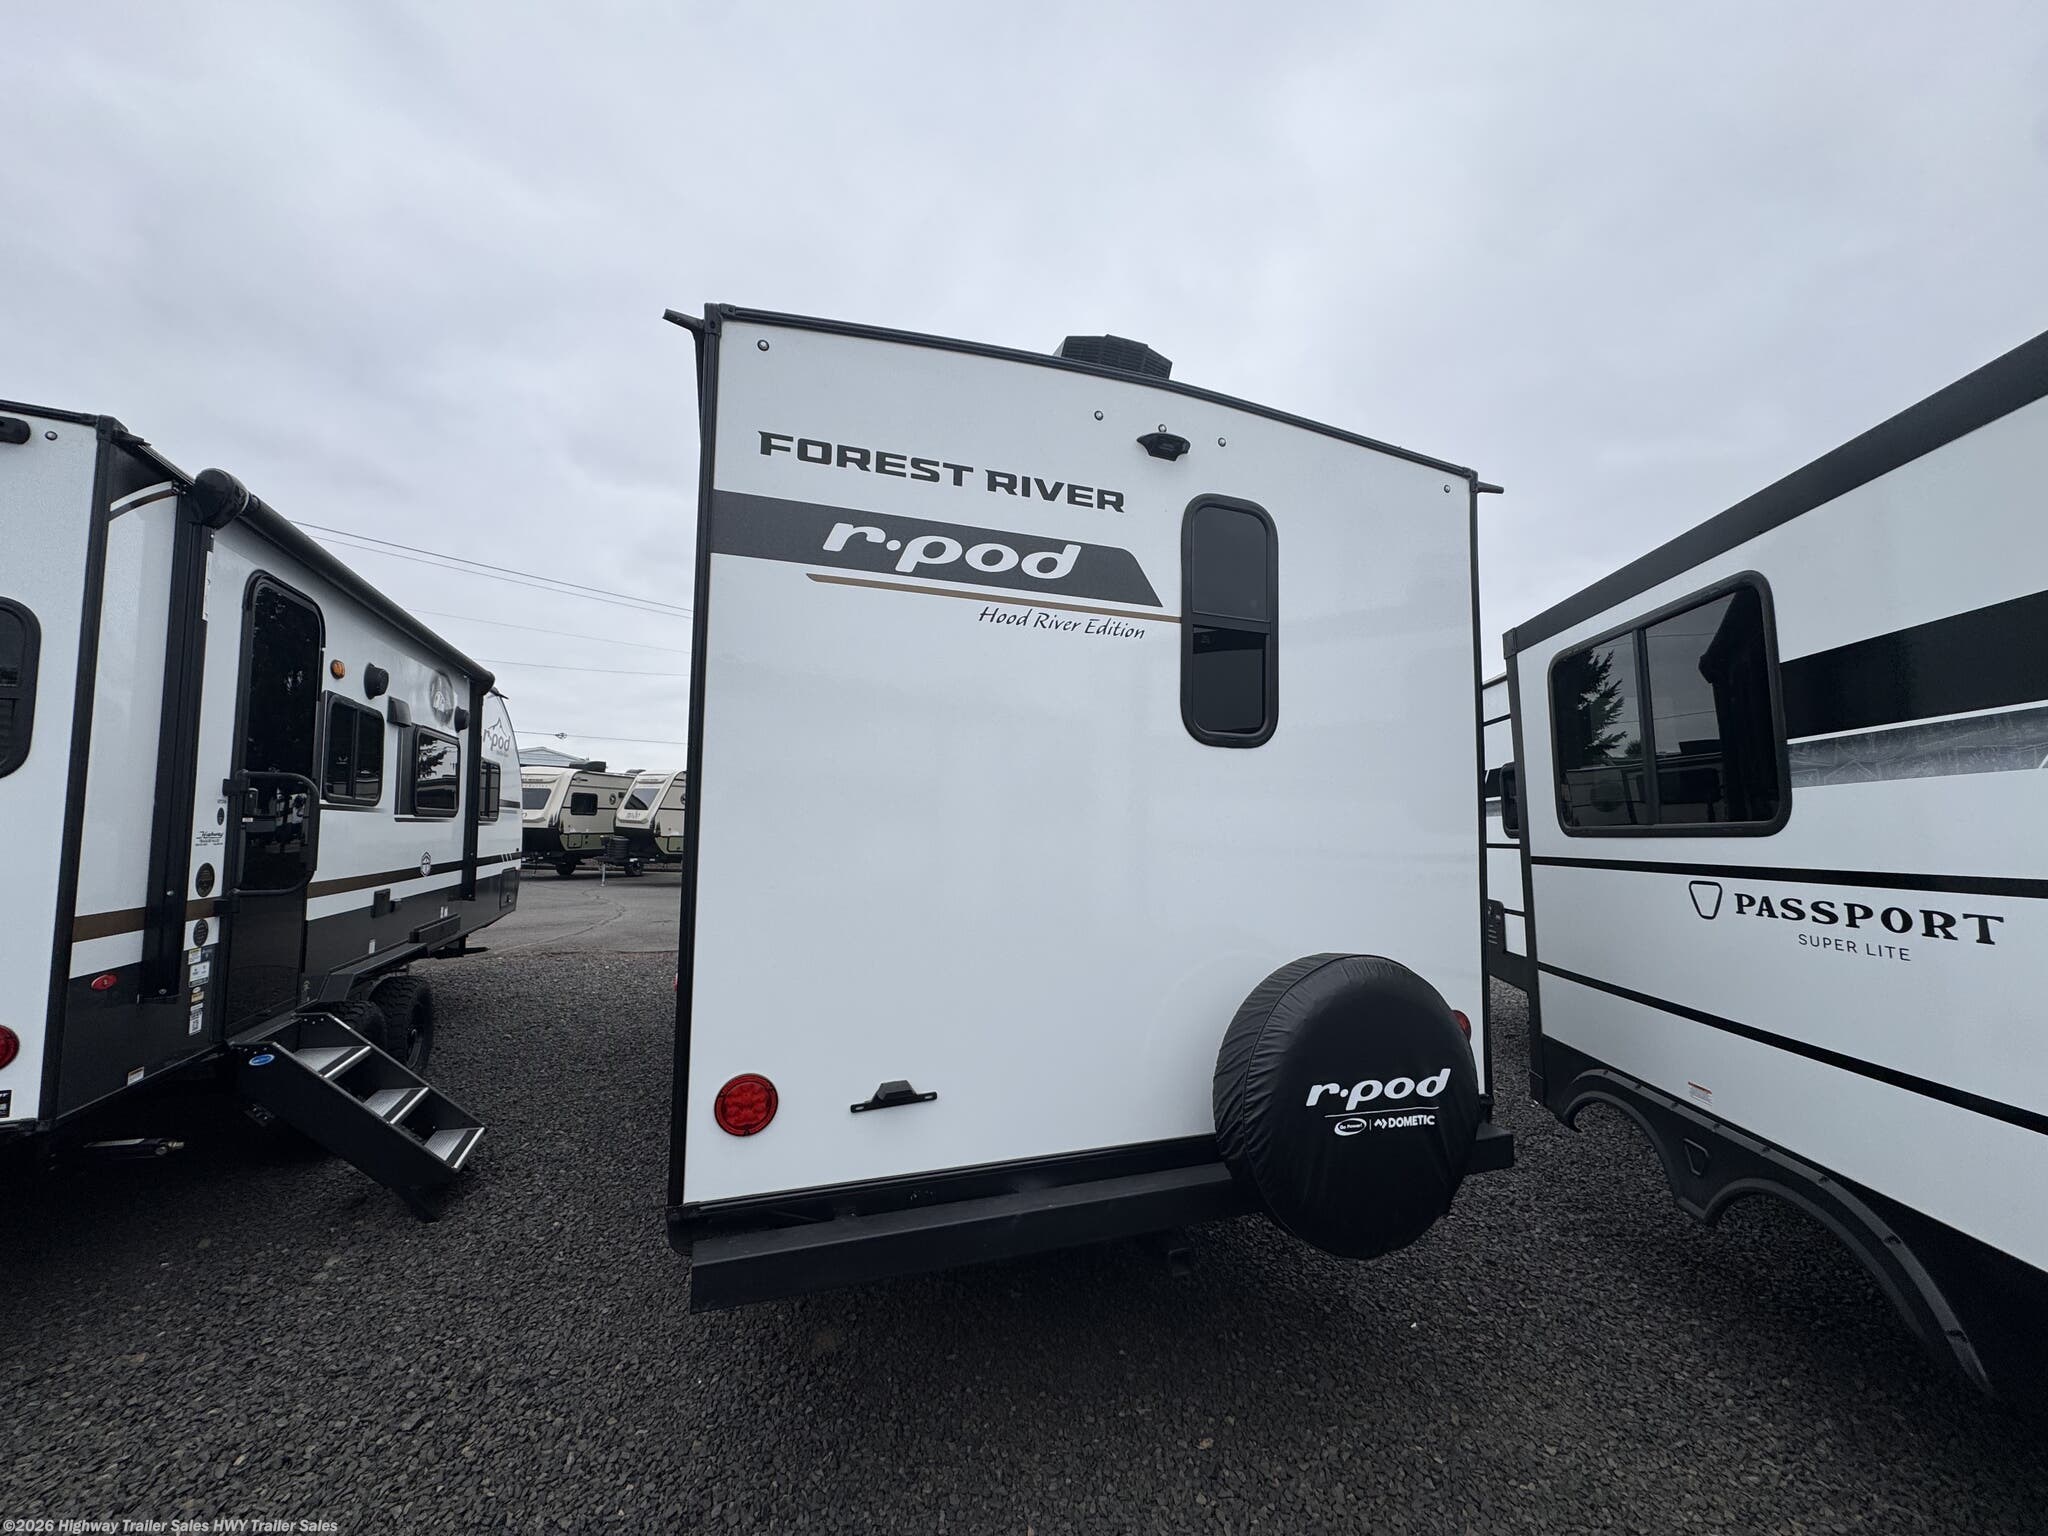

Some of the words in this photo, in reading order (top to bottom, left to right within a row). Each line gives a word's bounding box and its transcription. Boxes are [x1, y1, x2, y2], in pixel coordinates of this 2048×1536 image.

[758, 431, 974, 487] FOREST
[985, 470, 1125, 513] RIVER
[978, 606, 1033, 627] Hood
[1033, 612, 1082, 632] River
[1084, 618, 1146, 640] Edition
[1734, 893, 2004, 945] PASSPORT
[1798, 933, 1858, 954] SUPER
[1866, 943, 1911, 962] LITE
[1388, 1115, 1436, 1128] DOMETIC
